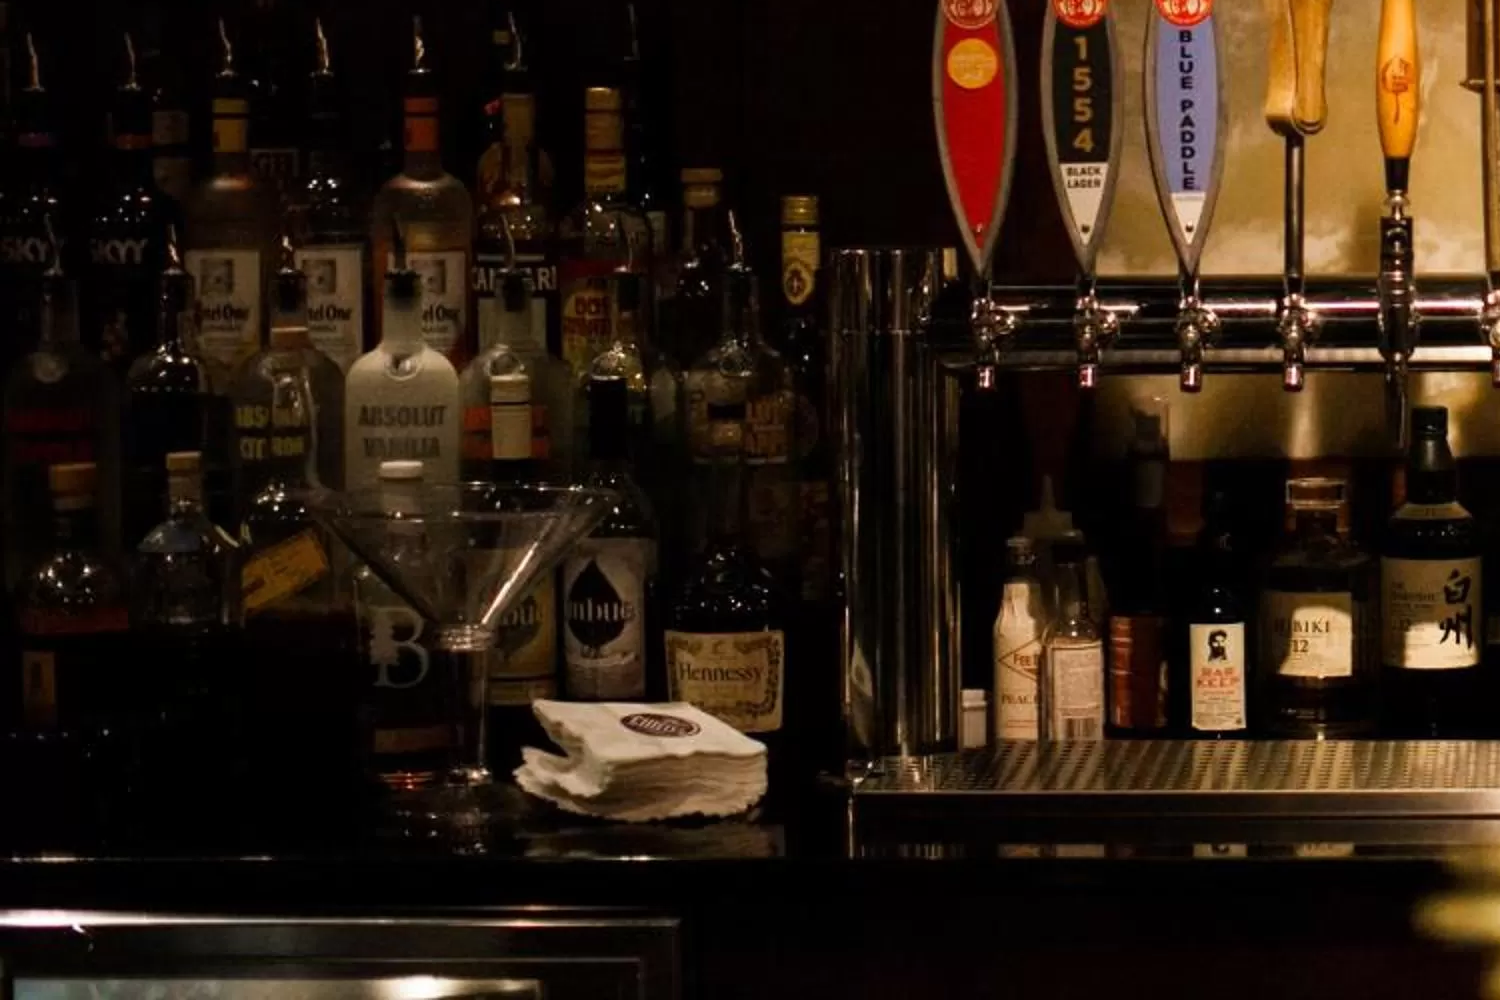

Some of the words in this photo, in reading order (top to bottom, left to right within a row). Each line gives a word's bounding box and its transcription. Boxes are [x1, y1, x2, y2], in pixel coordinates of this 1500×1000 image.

[1178, 30, 1195, 90] BLUE
[1072, 35, 1096, 154] 1554
[1179, 99, 1196, 192] PADDLE
[1066, 166, 1102, 177] BLACK
[1067, 179, 1101, 190] LAGER
[358, 404, 448, 428] ABSOLUT
[1291, 639, 1310, 653] 12
[680, 661, 764, 688] Hennessy
